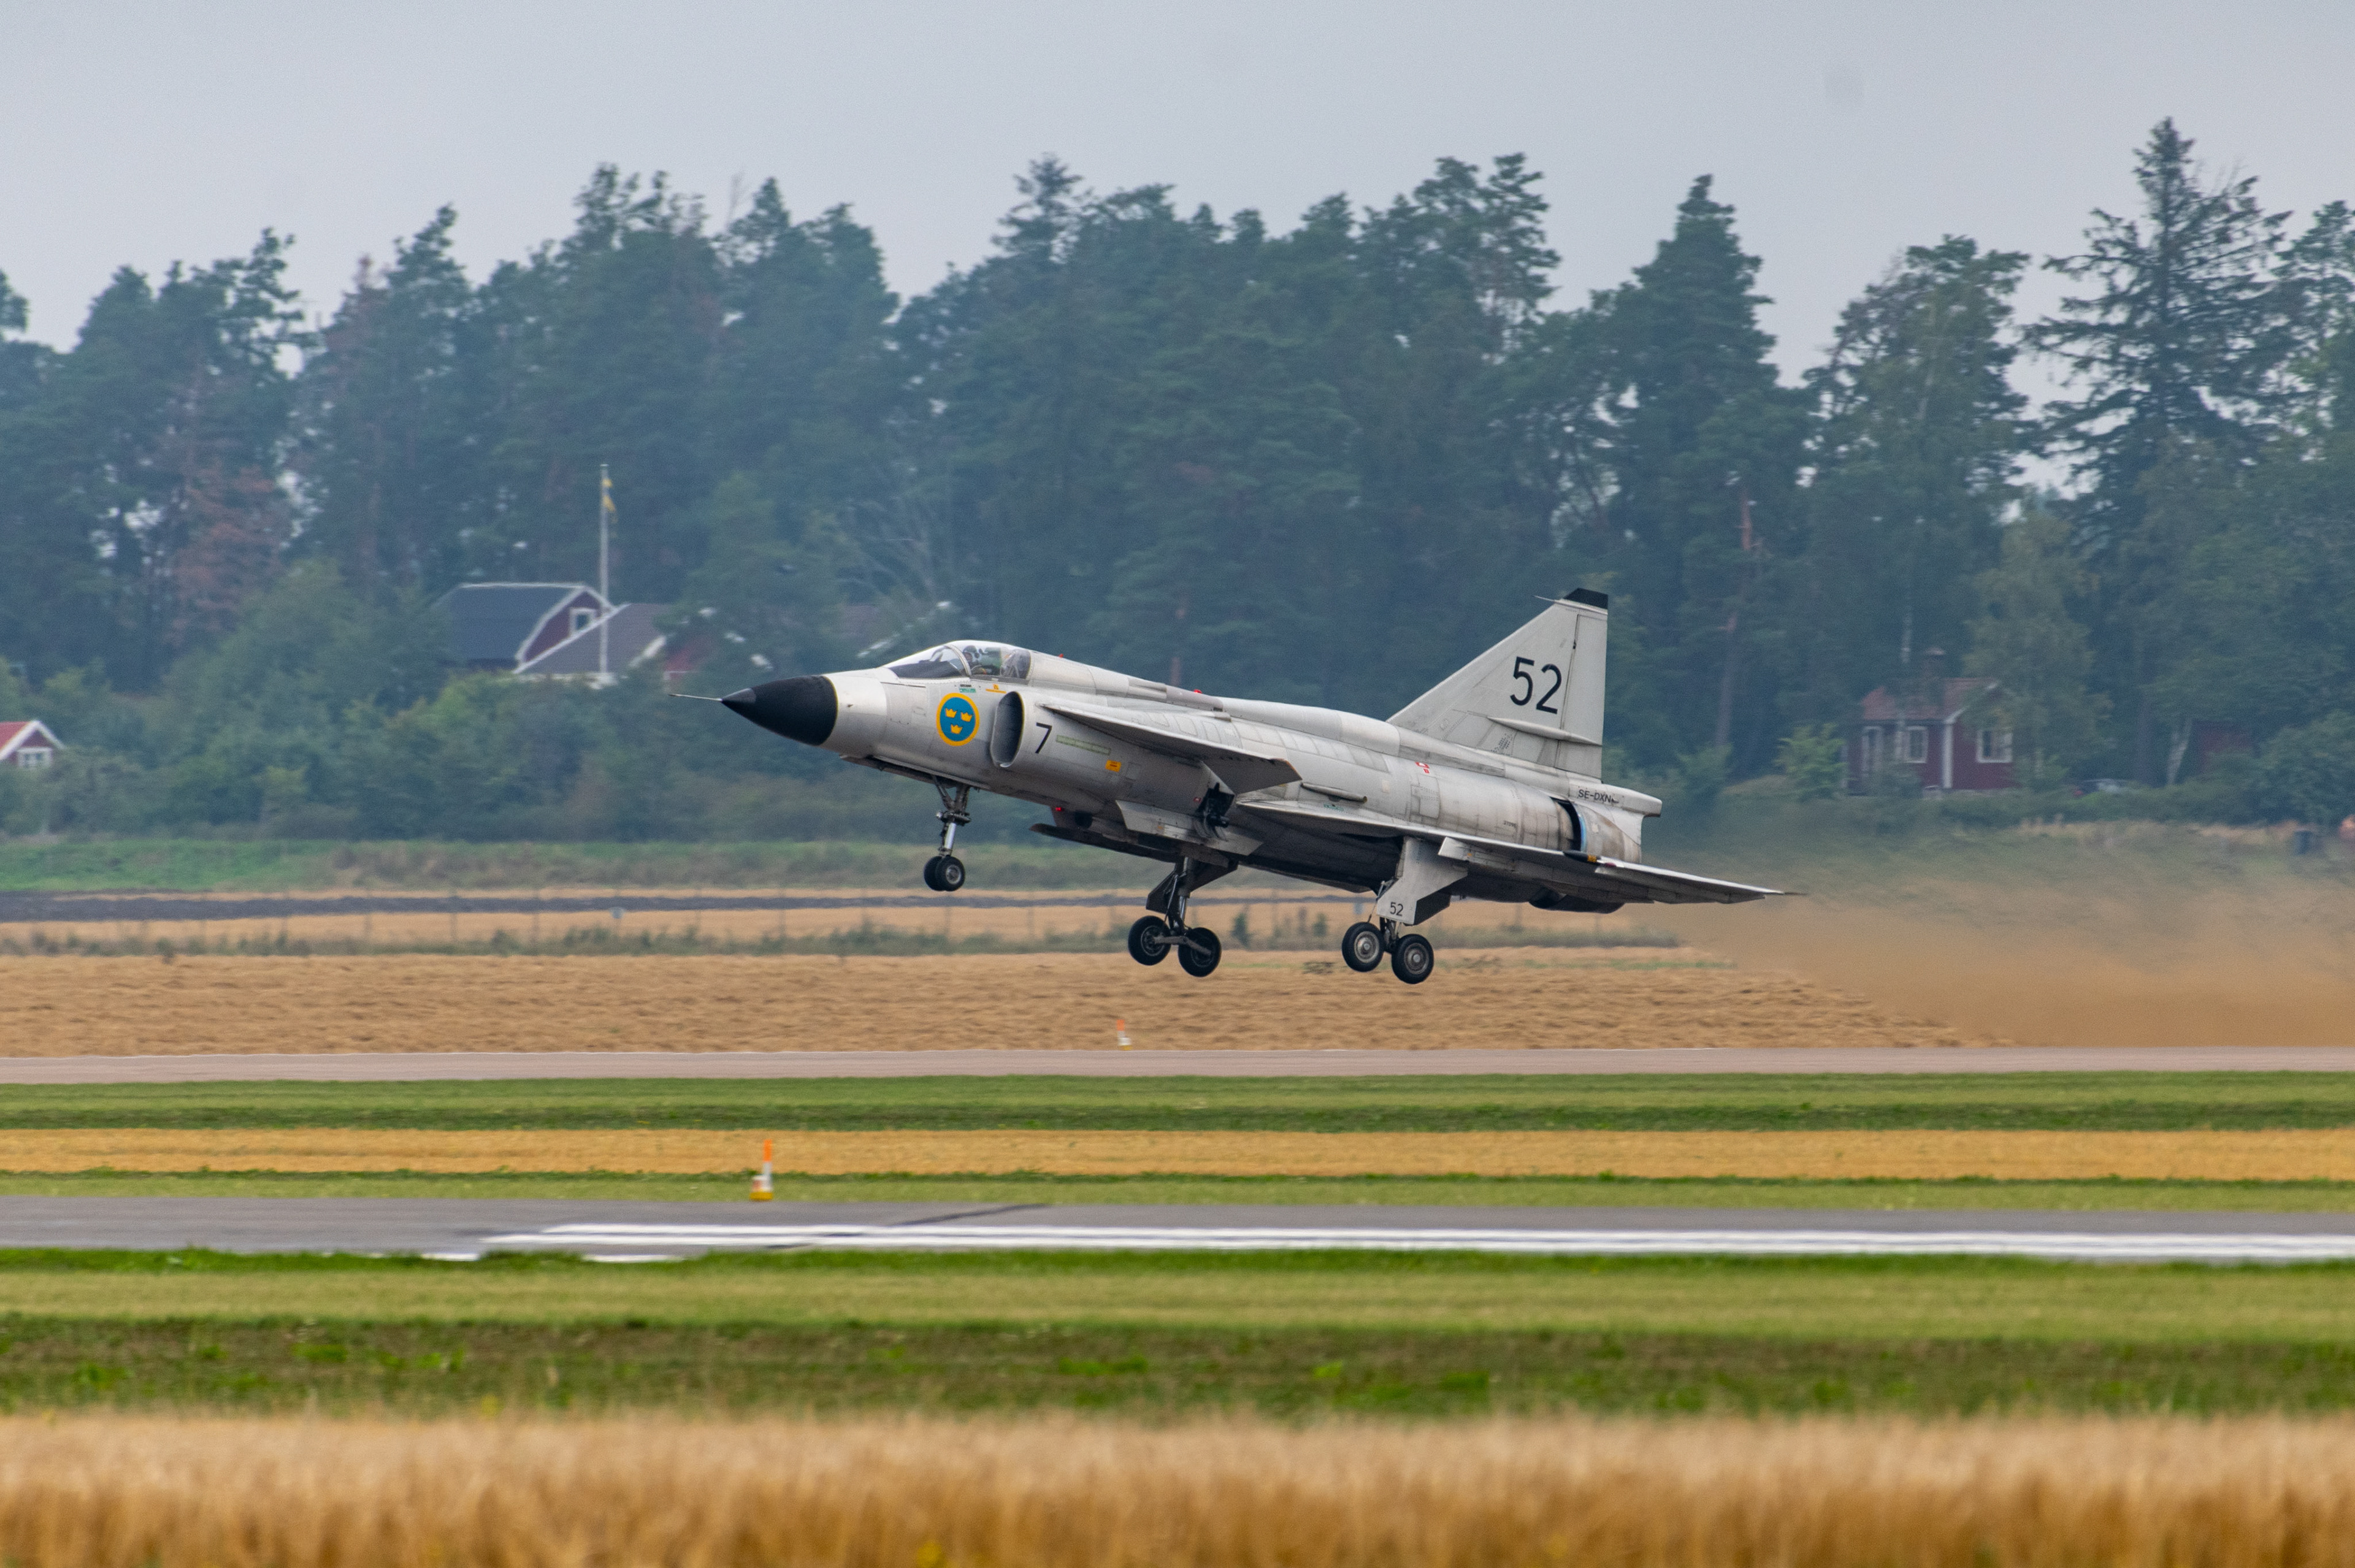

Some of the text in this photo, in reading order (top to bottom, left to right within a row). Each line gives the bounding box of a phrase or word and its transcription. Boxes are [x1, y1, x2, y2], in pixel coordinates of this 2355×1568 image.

[1510, 656, 1561, 714] 52
[1035, 722, 1052, 754] 7
[1578, 789, 1612, 803] SE-DXN
[1390, 901, 1403, 916] 52
